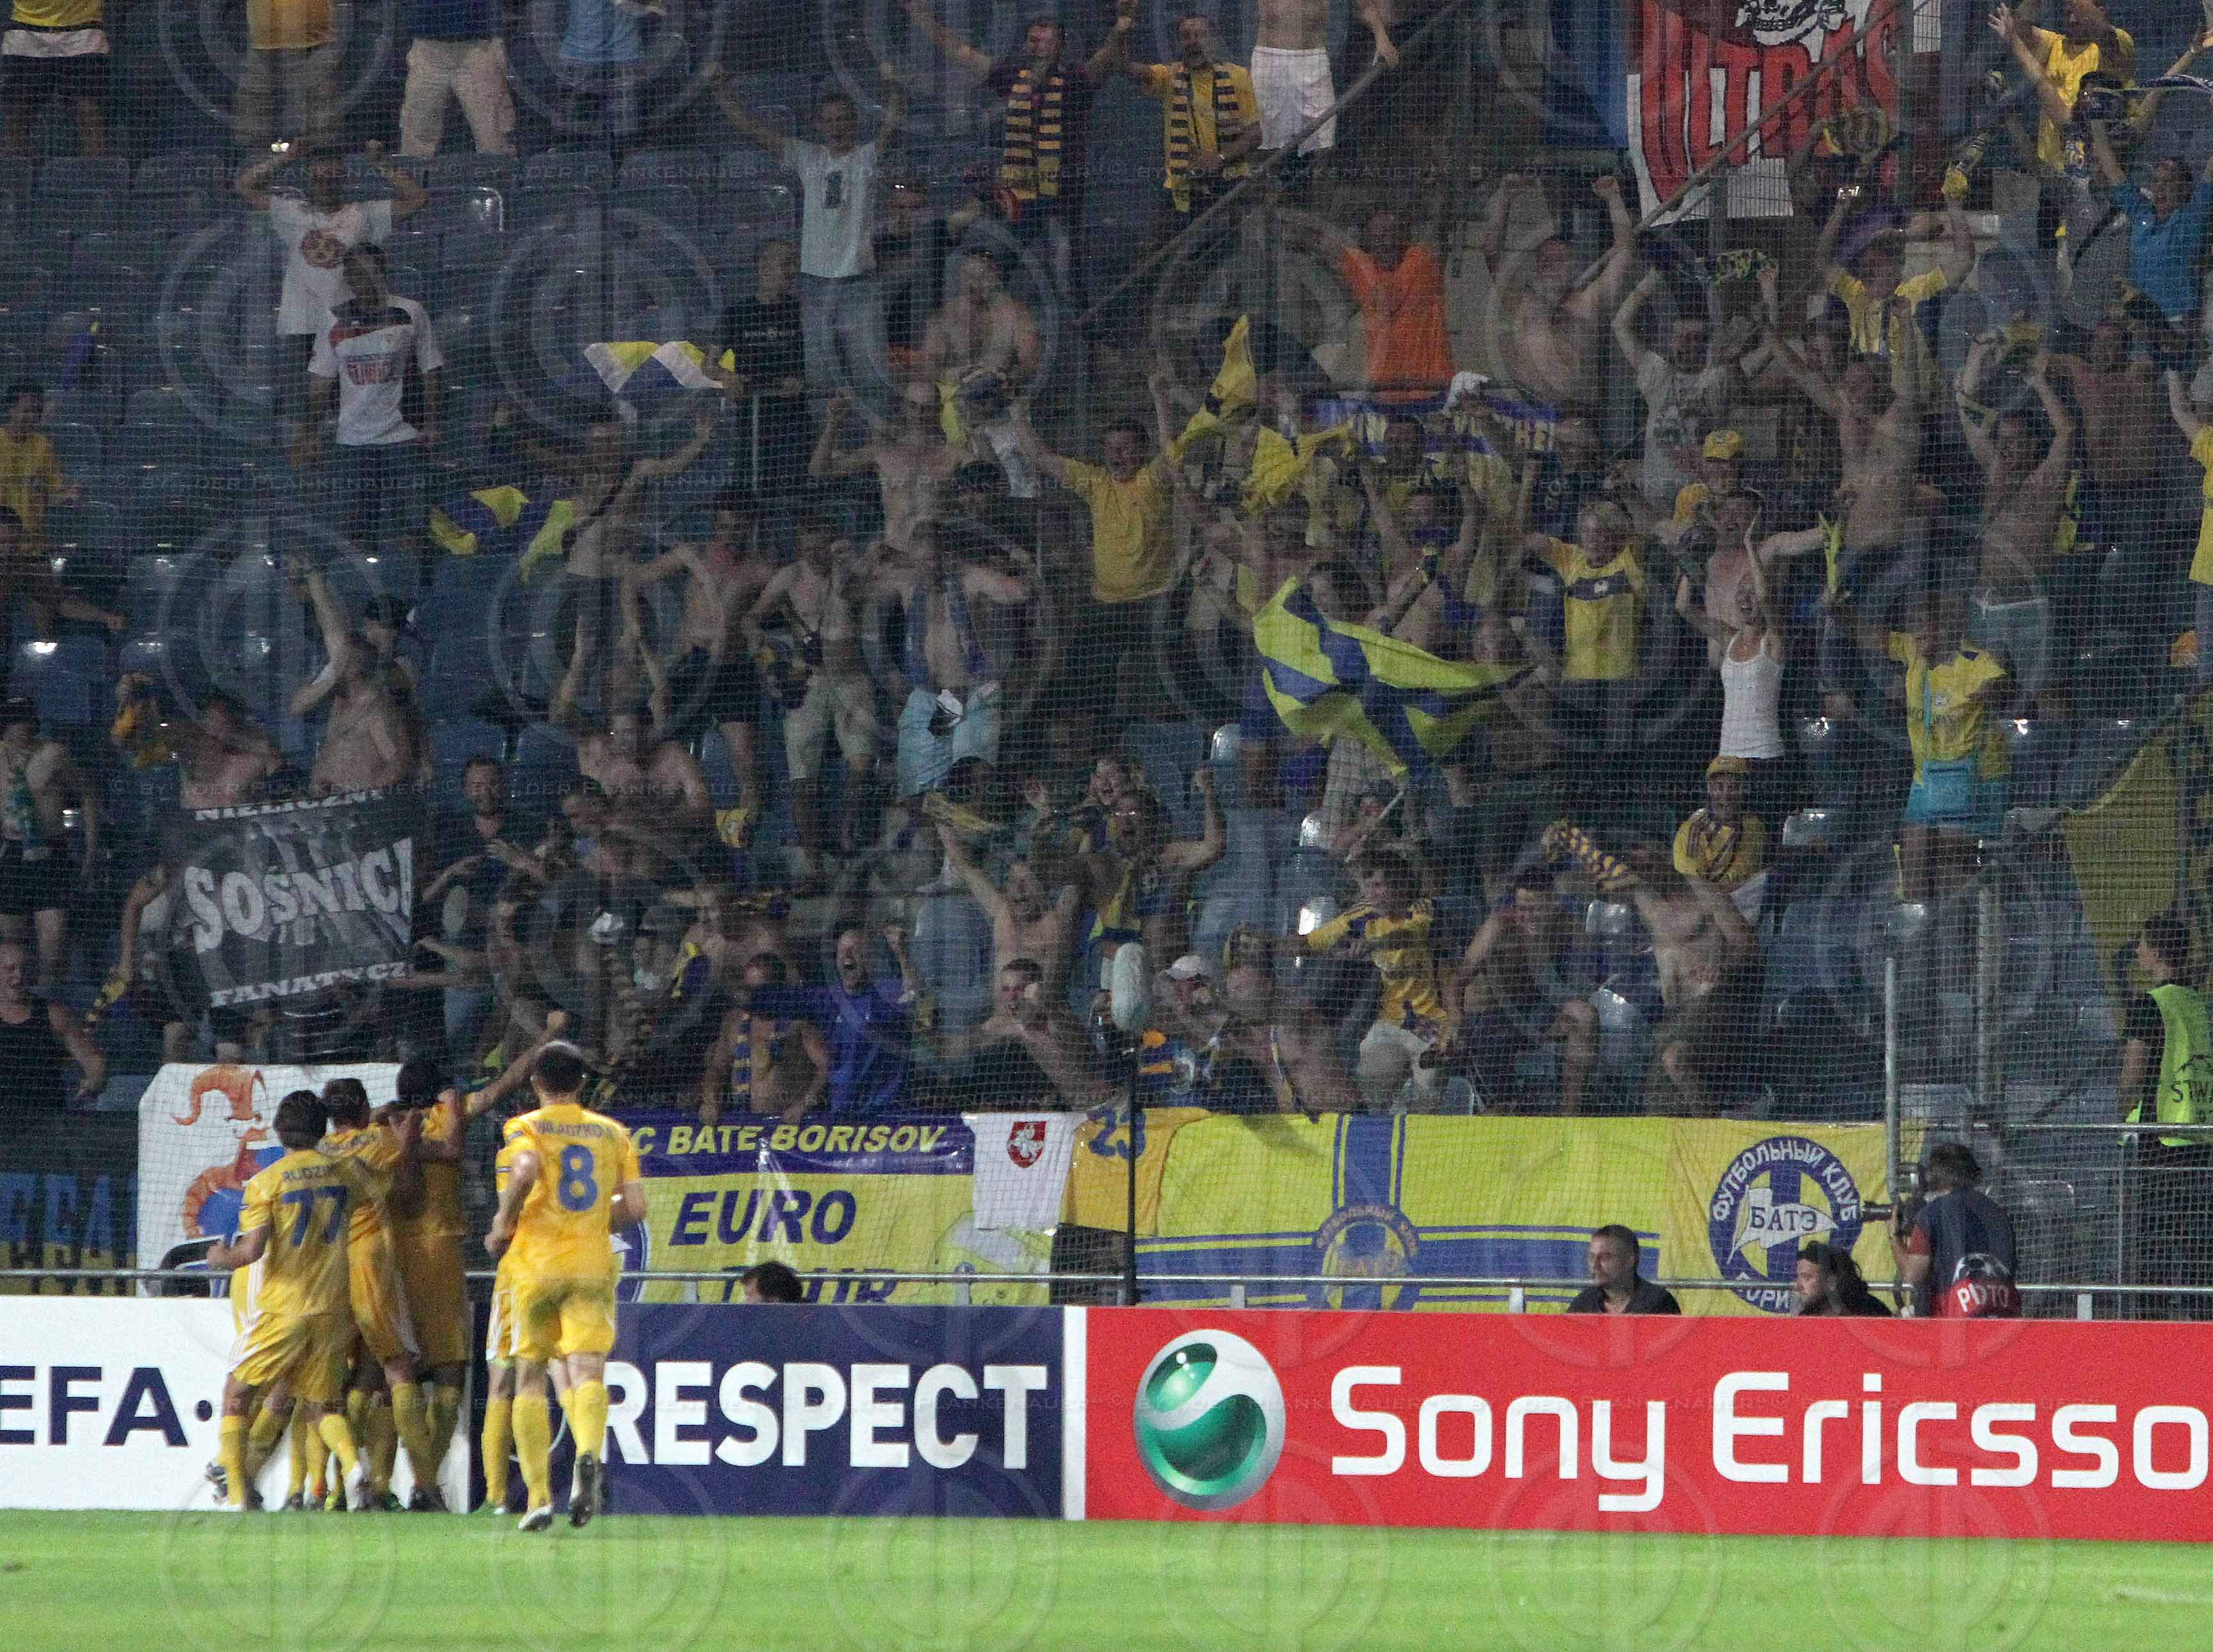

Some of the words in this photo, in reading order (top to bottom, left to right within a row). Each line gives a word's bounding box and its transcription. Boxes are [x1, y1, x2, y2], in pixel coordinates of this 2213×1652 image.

[668, 1125, 768, 1154] BATE
[770, 1124, 948, 1153] BORISOV
[556, 1144, 598, 1211] 8
[1713, 1140, 1826, 1221] ФУТБОЛЬНЫЙ
[1822, 1162, 1860, 1222] КЛУБ
[281, 1185, 349, 1247] 77
[669, 1189, 857, 1245] EURO
[1749, 1206, 1818, 1232] БАТЭ
[601, 1359, 1048, 1470] RESPECT
[1330, 1365, 1666, 1512] Sony
